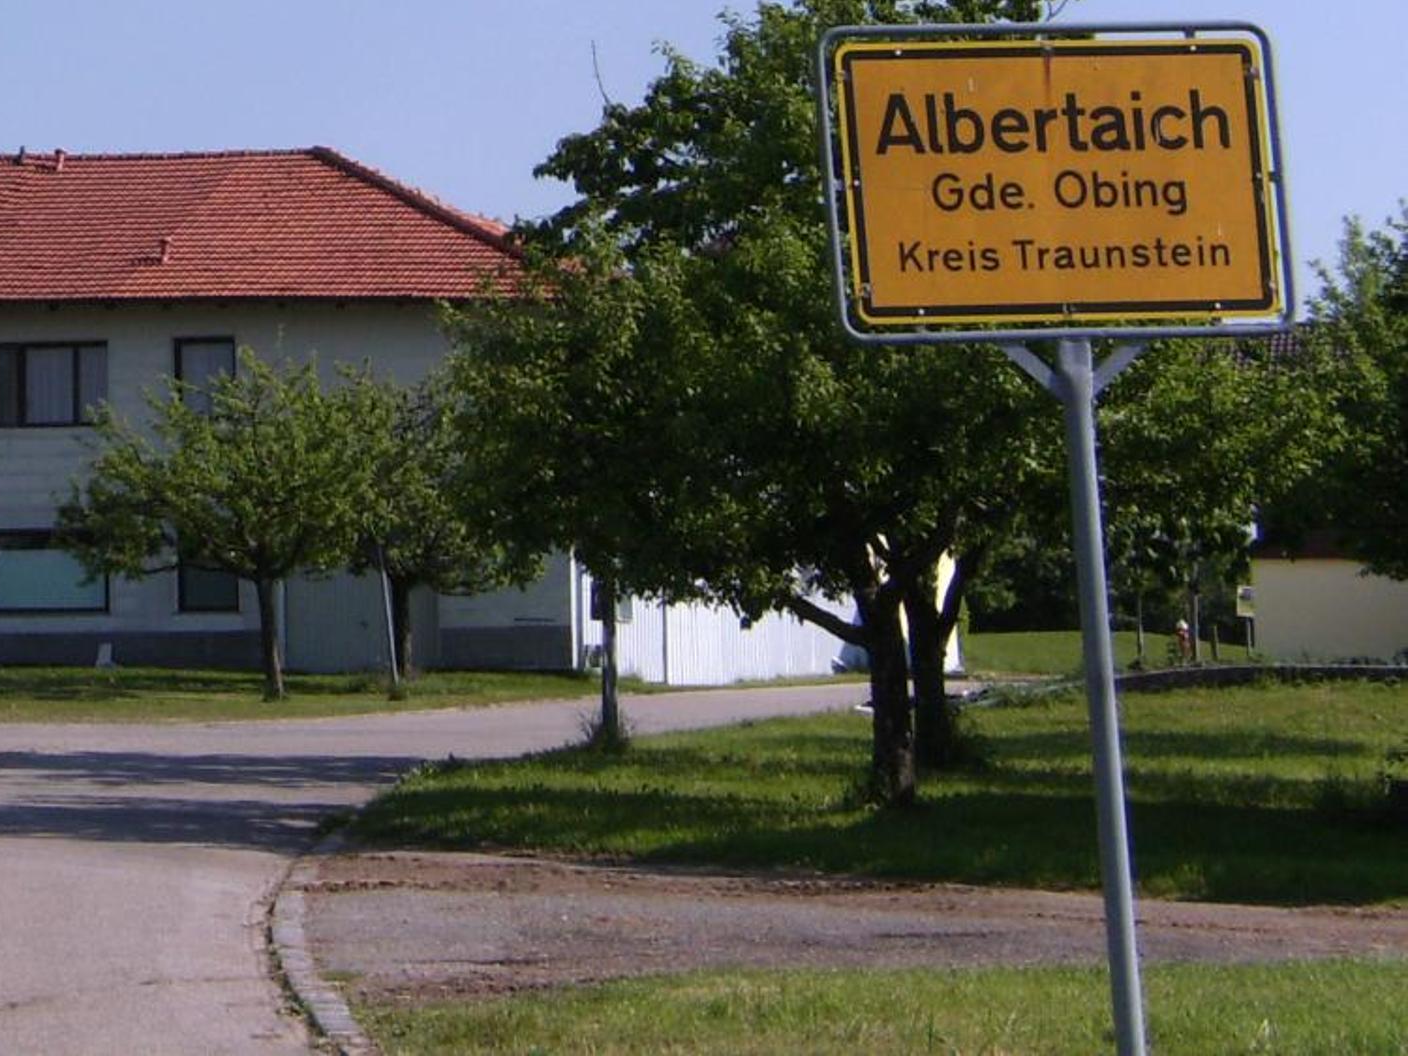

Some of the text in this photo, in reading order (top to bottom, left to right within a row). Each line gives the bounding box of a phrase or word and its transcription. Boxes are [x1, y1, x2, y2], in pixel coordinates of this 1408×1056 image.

[876, 89, 1231, 156] Albertaich
[931, 169, 1189, 216] Gde. Obing
[898, 236, 1232, 273] Kreis Traunstein
